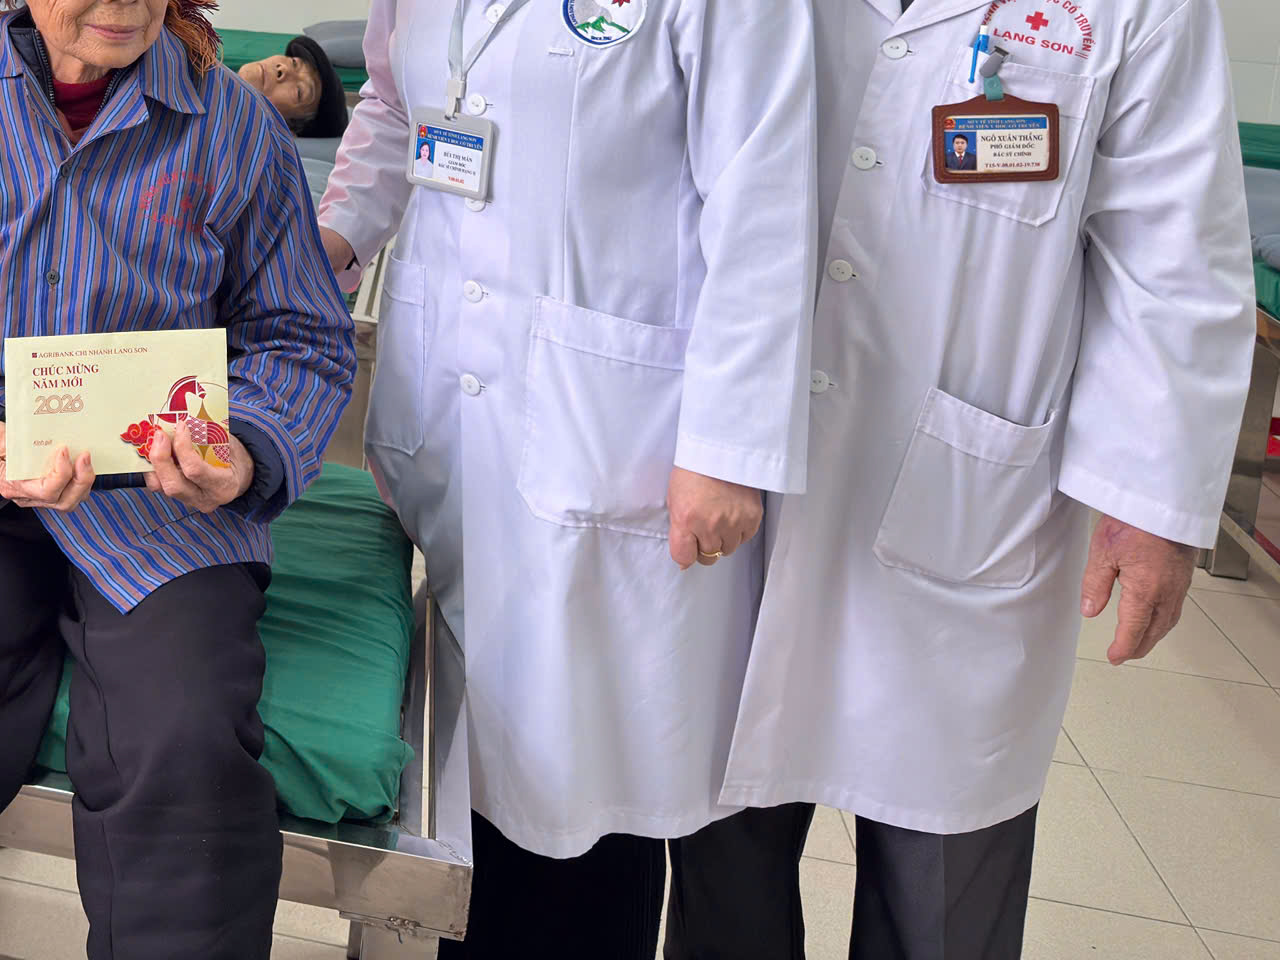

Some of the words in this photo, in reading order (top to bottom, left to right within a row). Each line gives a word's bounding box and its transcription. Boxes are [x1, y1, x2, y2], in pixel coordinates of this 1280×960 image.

[993, 28, 1036, 46] LẠNG
[1040, 39, 1074, 55] SƠN
[980, 134, 997, 142] NGÔ
[997, 133, 1017, 142] XUÂN
[38, 350, 75, 359] AGRIBANK
[32, 364, 64, 377] CHÚC
[66, 363, 99, 375] MỪNG
[33, 378, 58, 390] NĂM
[61, 376, 83, 388] MỚI
[33, 394, 85, 415] 2026
